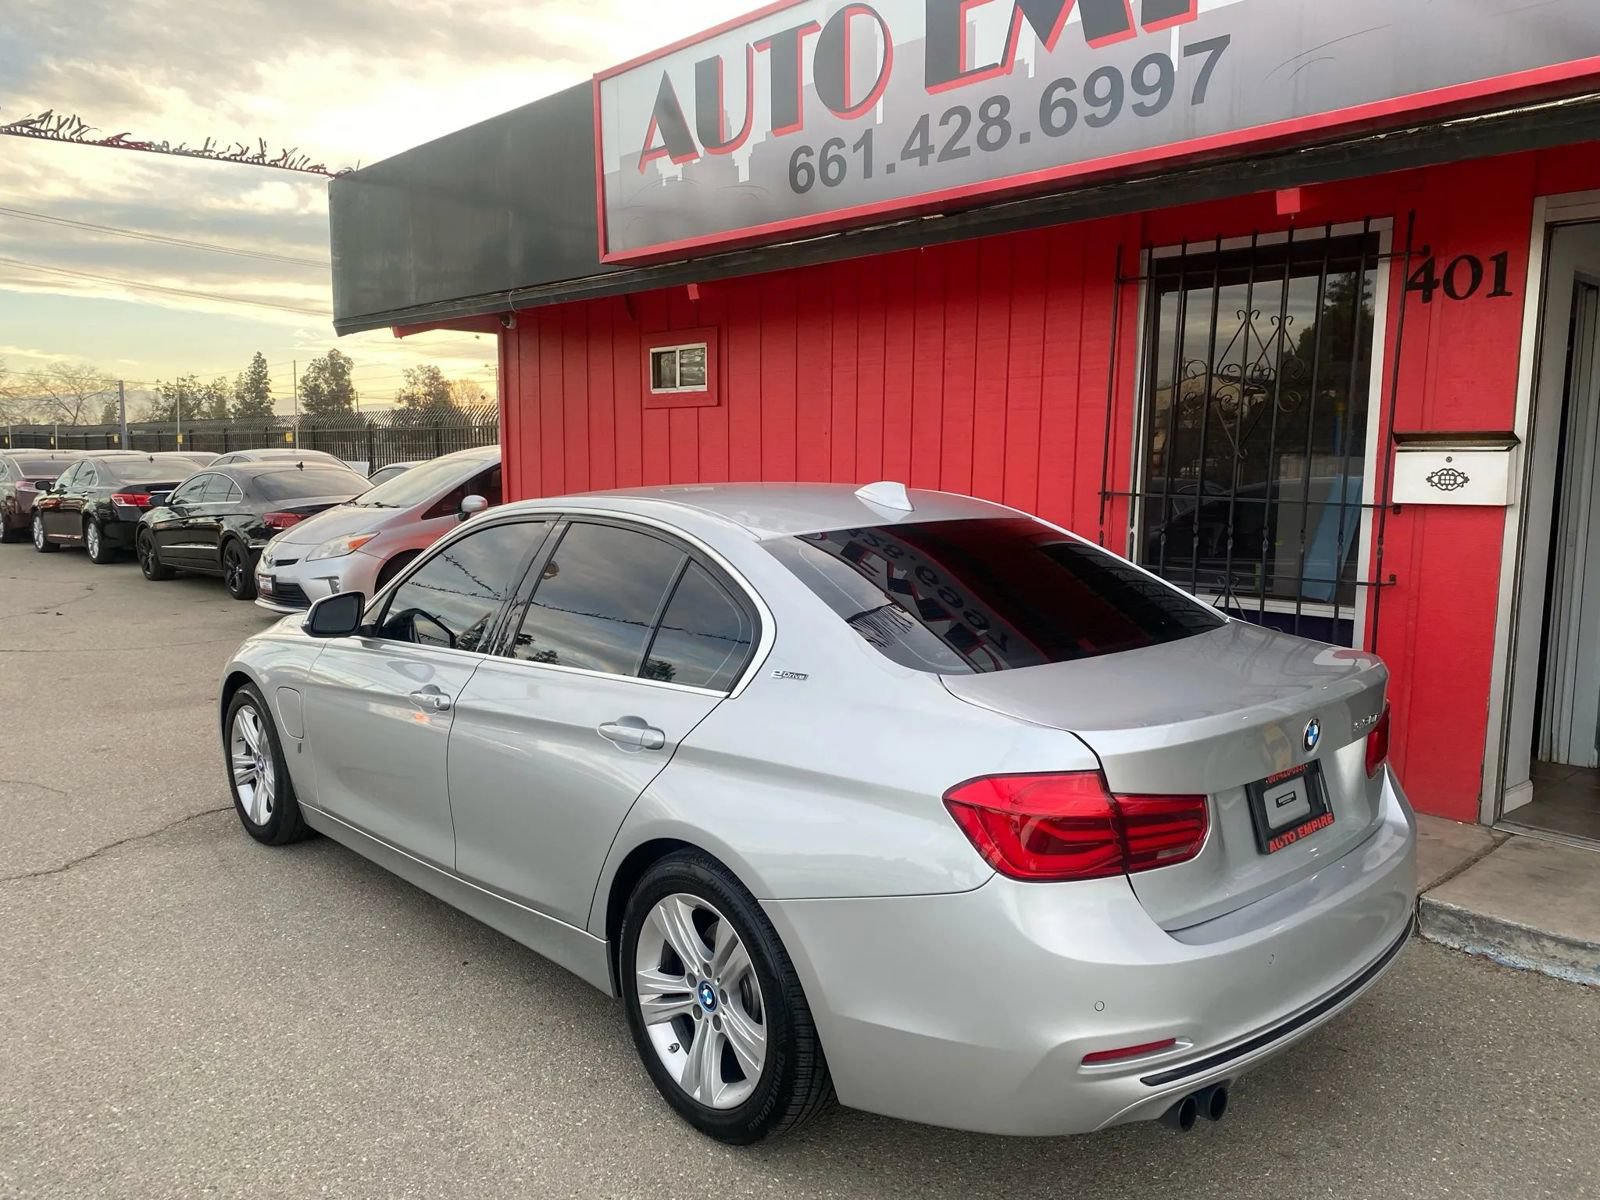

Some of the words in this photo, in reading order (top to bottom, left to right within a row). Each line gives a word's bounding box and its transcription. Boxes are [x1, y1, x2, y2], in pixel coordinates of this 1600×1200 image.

[638, 2, 894, 176] AUTO
[788, 34, 1231, 195] 661.428.6997
[1406, 250, 1513, 304] 401
[1269, 831, 1297, 853] AUTO
[1297, 812, 1334, 838] EMPIRE
